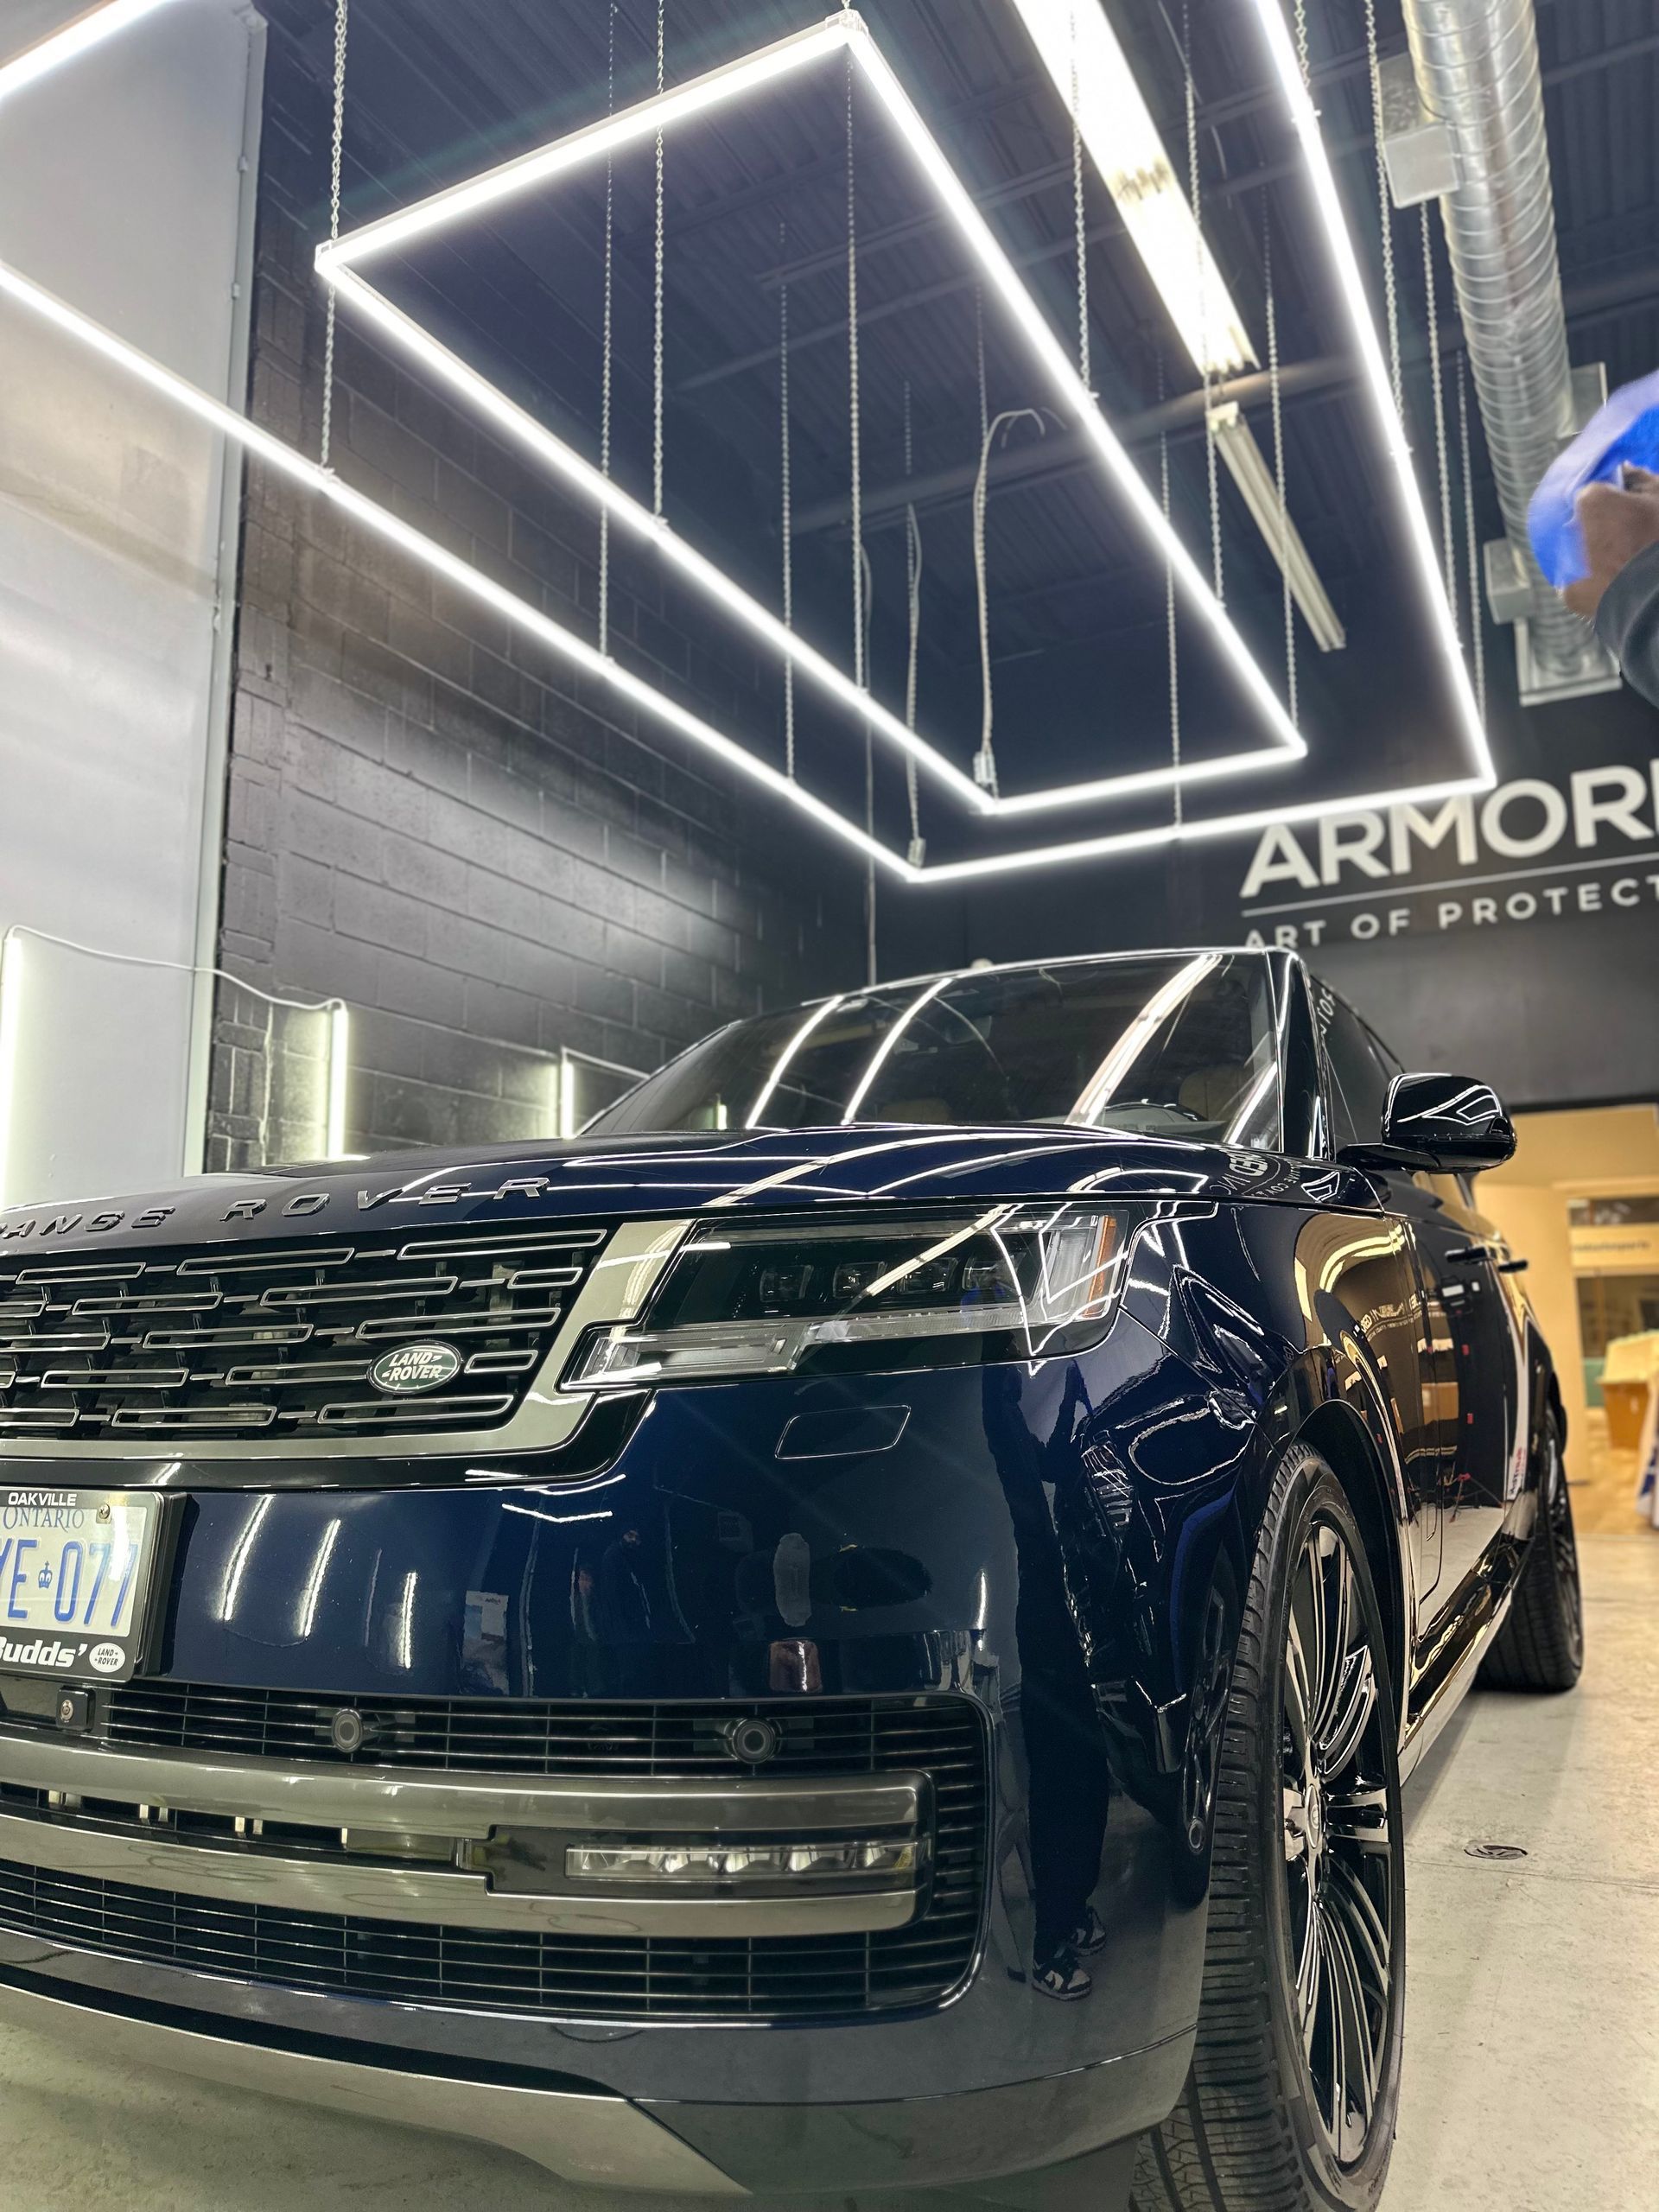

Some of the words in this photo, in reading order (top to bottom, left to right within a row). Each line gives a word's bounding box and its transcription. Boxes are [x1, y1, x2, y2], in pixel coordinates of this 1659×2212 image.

[1239, 757, 1659, 898] ARMOR
[1245, 919, 1326, 951] ART
[1351, 909, 1411, 939] OF
[220, 1177, 551, 1222] ROVER
[389, 1351, 433, 1367] LAND
[389, 1364, 443, 1382] ROVER
[8, 1492, 77, 1507] OAKVILLE
[98, 1648, 113, 1656] LAND
[98, 1657, 118, 1666] ROVER
